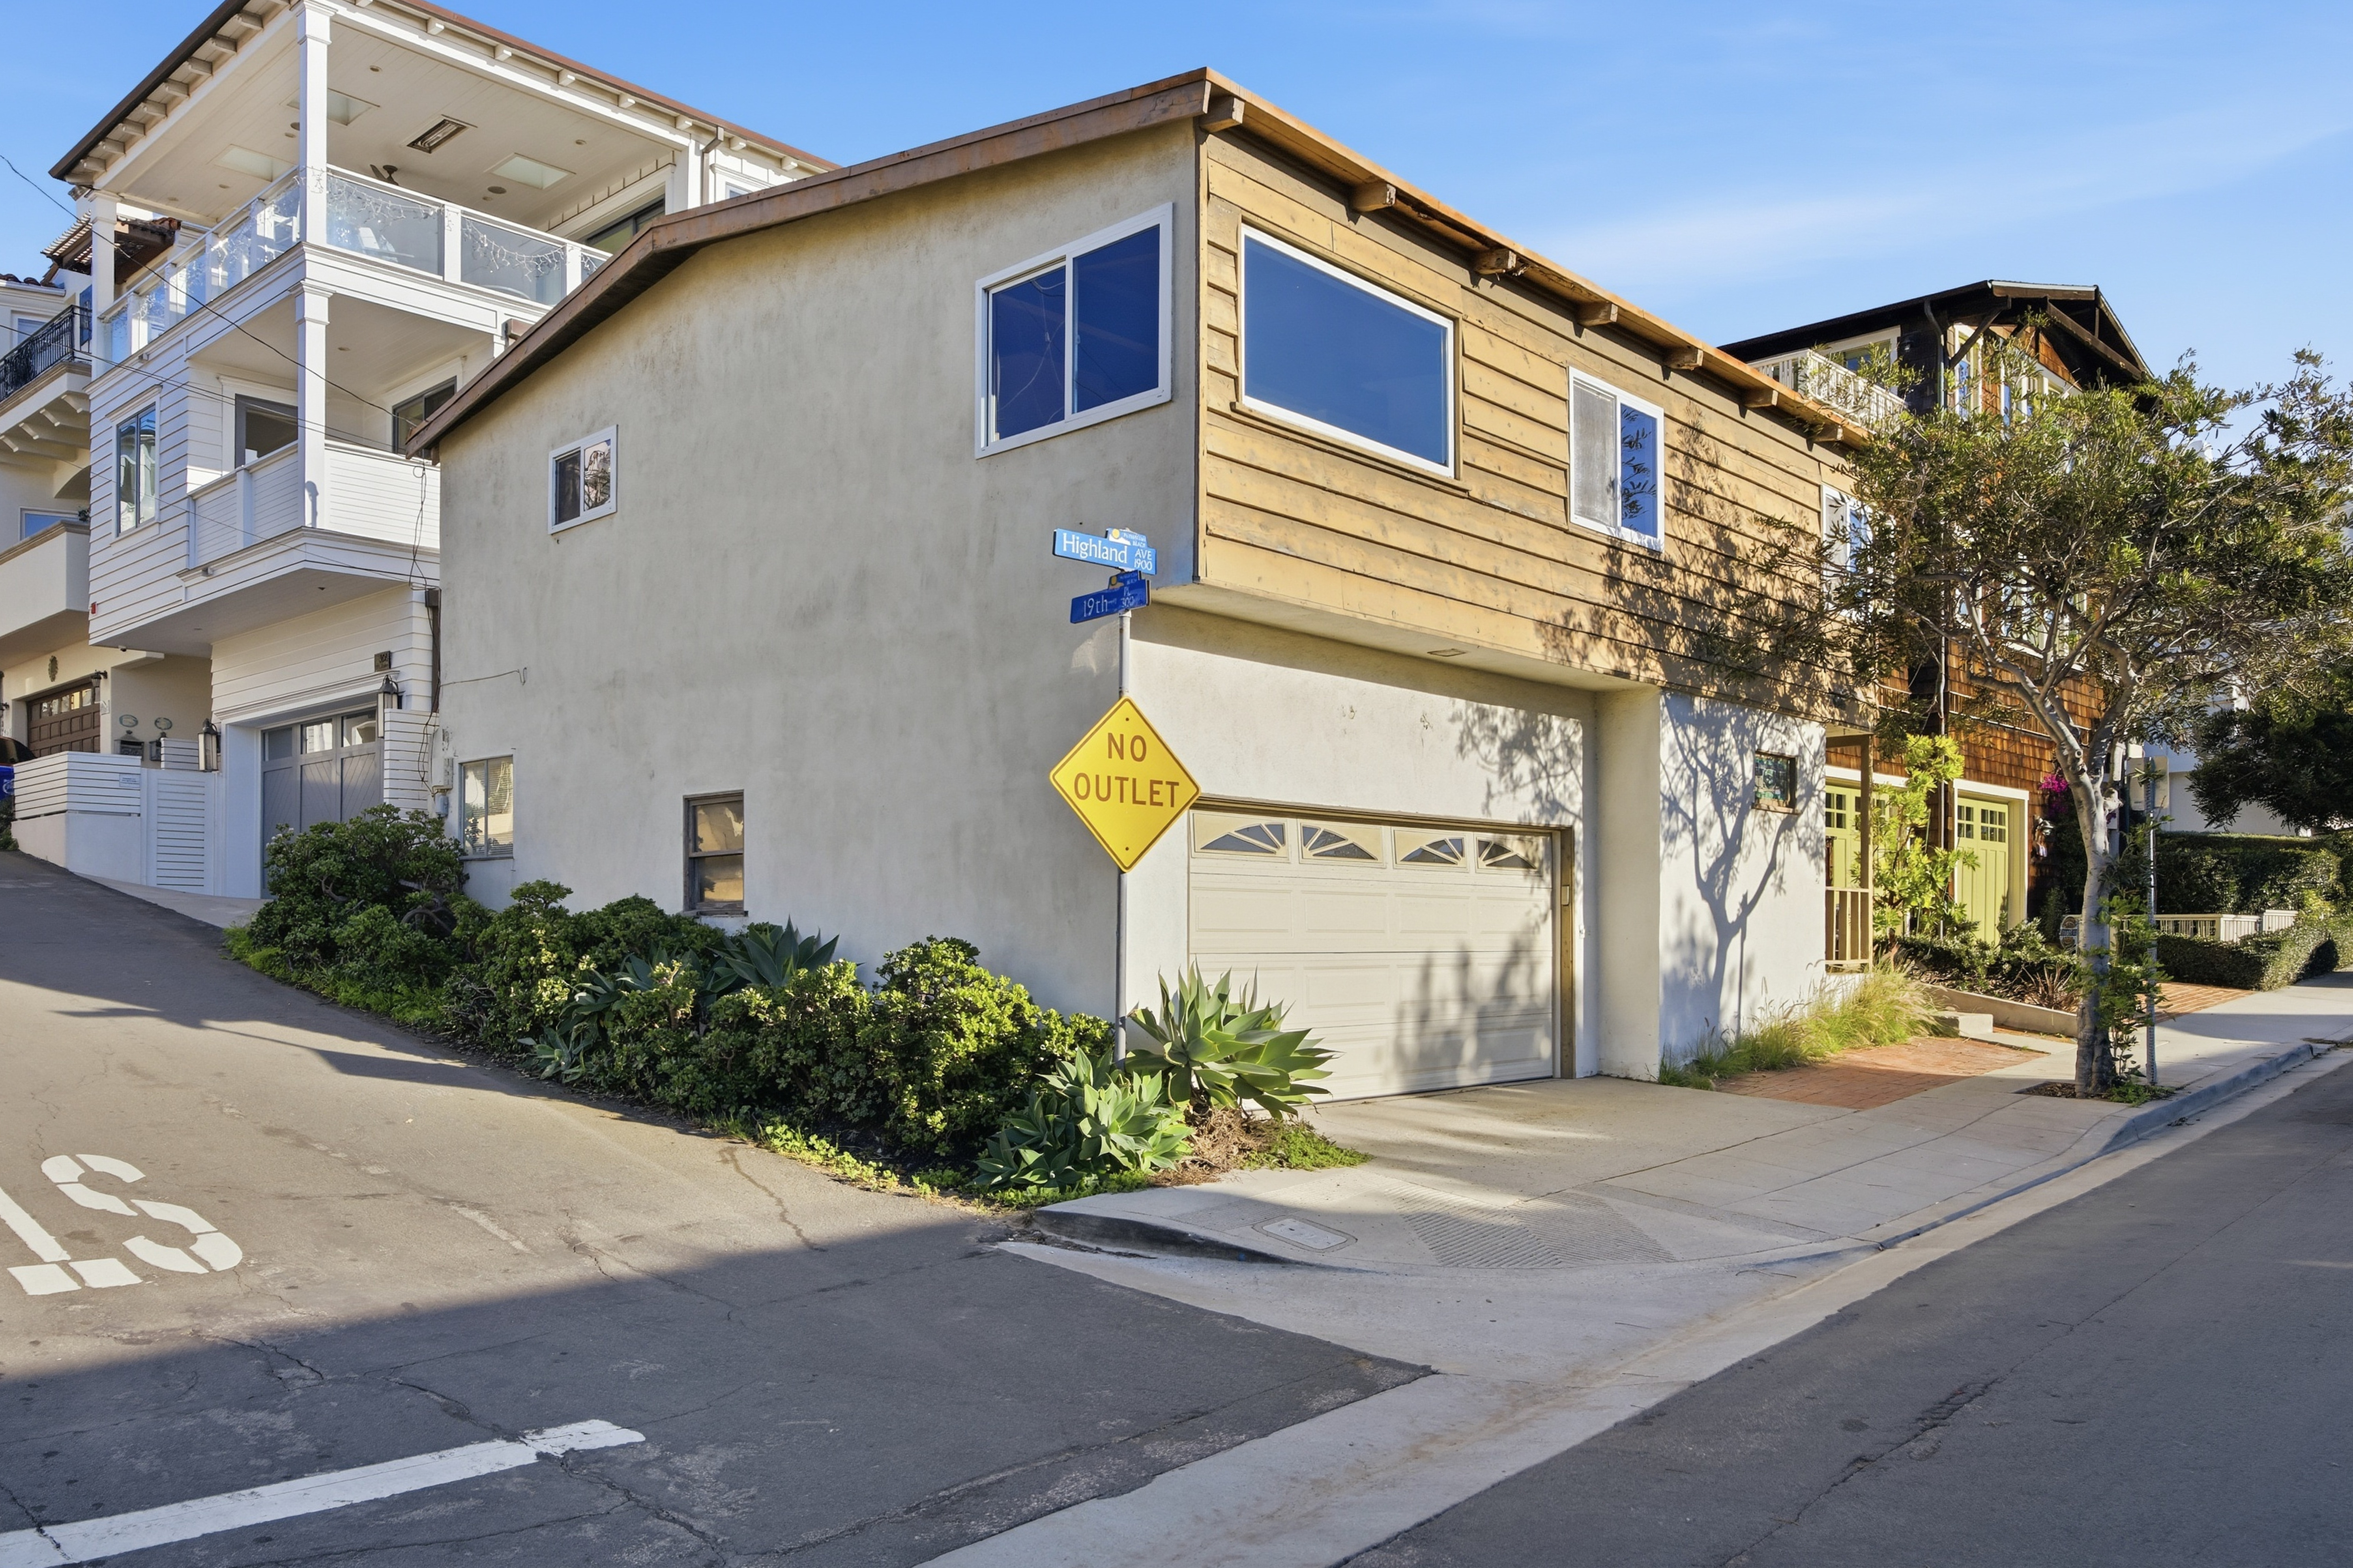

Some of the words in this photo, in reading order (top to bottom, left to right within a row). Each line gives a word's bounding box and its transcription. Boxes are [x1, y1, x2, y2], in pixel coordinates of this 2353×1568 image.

[1063, 532, 1127, 564] Highland
[1135, 548, 1152, 560] AVE
[1134, 559, 1152, 571] 1900
[1124, 586, 1131, 596] PL
[1084, 595, 1108, 617] 19th
[1108, 732, 1147, 762] NO
[1074, 772, 1179, 808] OUTLET
[0, 1154, 243, 1295] ST
